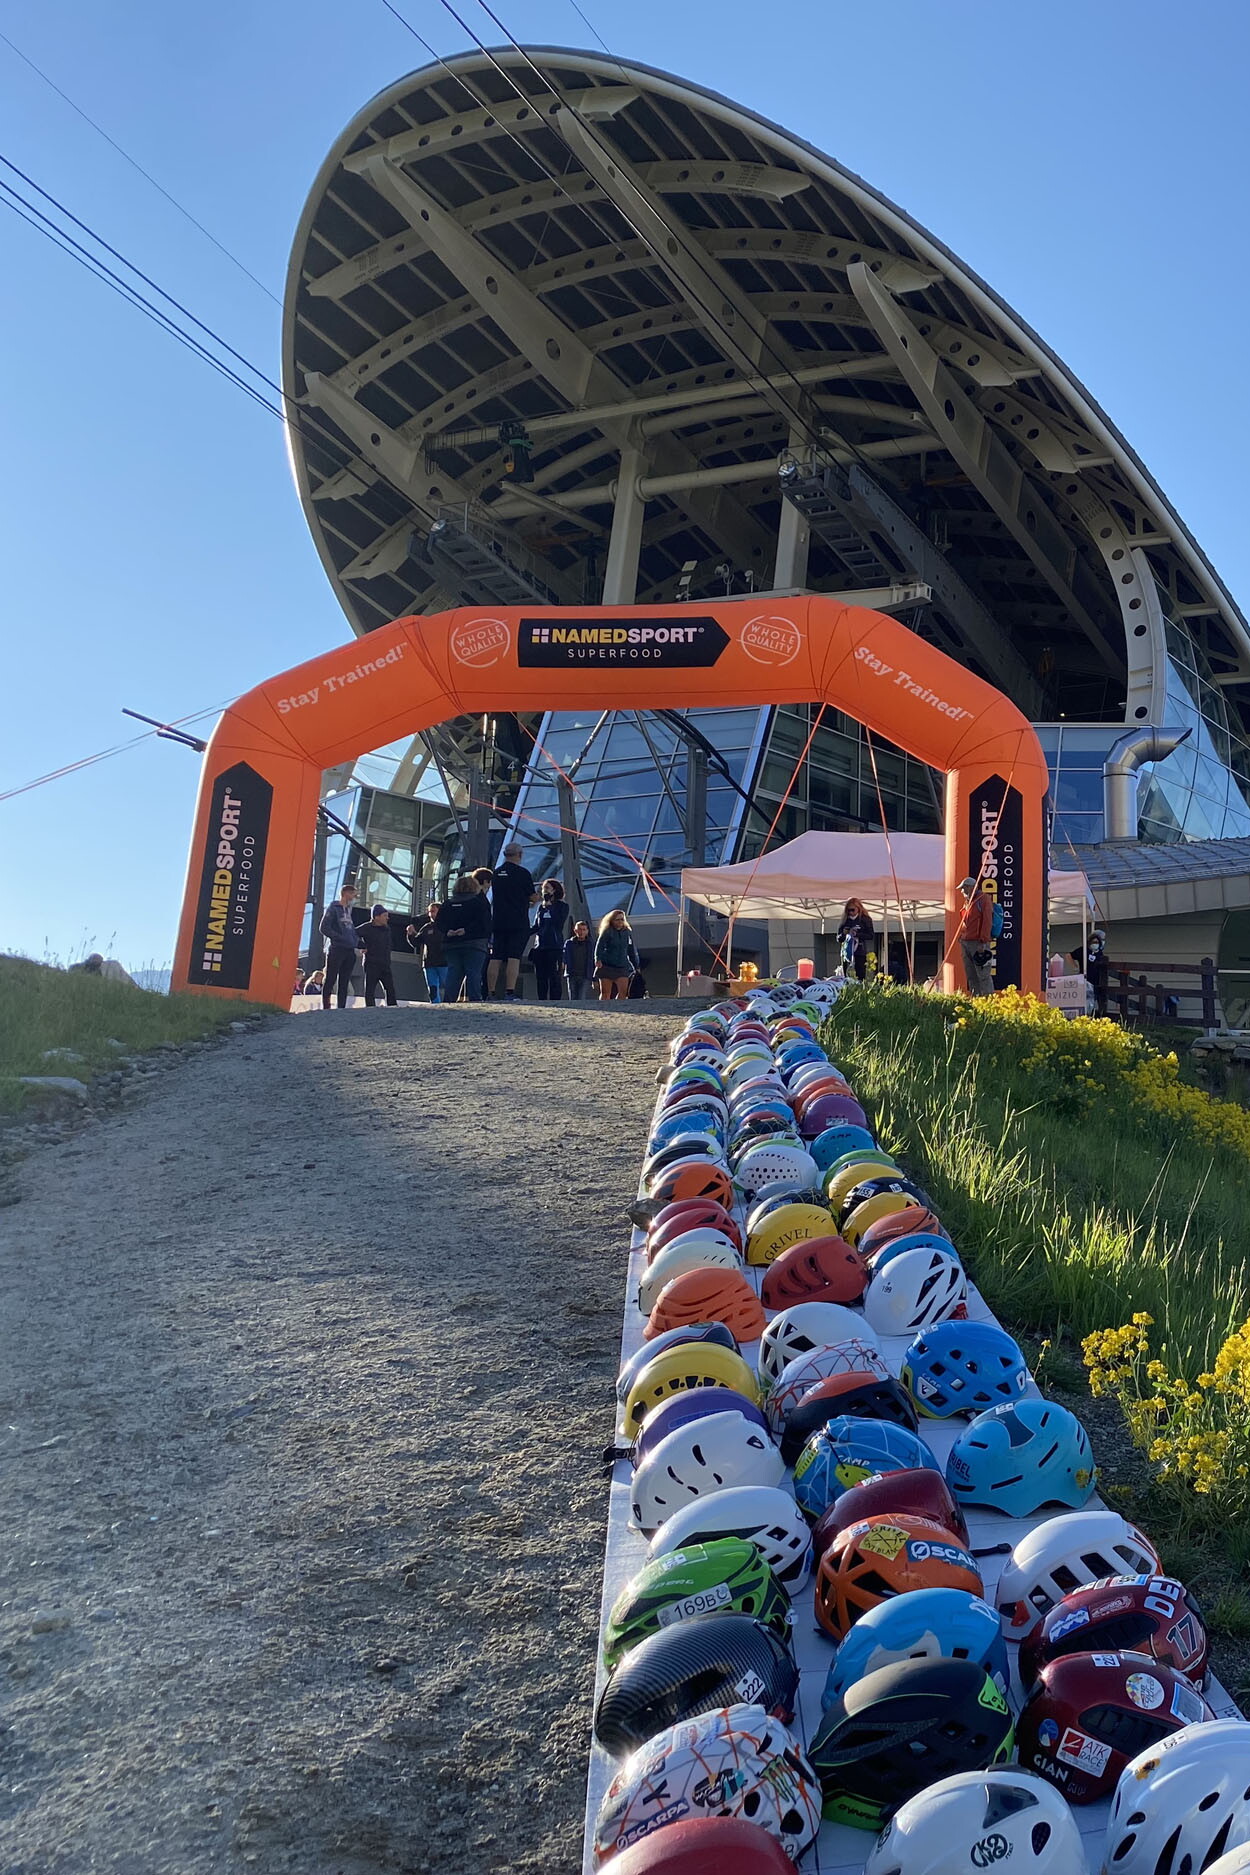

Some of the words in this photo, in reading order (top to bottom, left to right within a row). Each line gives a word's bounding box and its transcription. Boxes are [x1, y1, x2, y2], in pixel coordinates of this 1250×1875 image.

[456, 625, 501, 648] WHOLE
[461, 632, 505, 657] QUALITY
[747, 633, 794, 654] QUALITY
[751, 624, 796, 645] WHOLE
[567, 648, 662, 659] SUPERFOOD
[853, 646, 893, 676] Stay
[277, 687, 320, 714] Stay
[232, 835, 256, 935] SUPERFOOD
[1003, 843, 1014, 939] SUPERFOOD
[764, 1228, 813, 1261] GRIVEL
[921, 1372, 942, 1389] CAMP
[1165, 1611, 1199, 1661] 17
[742, 1677, 764, 1701] 222
[1079, 1751, 1105, 1768] RACE
[1082, 1741, 1110, 1759] ATK
[1033, 1752, 1069, 1783] GIAN
[627, 1801, 689, 1843] SCARPA
